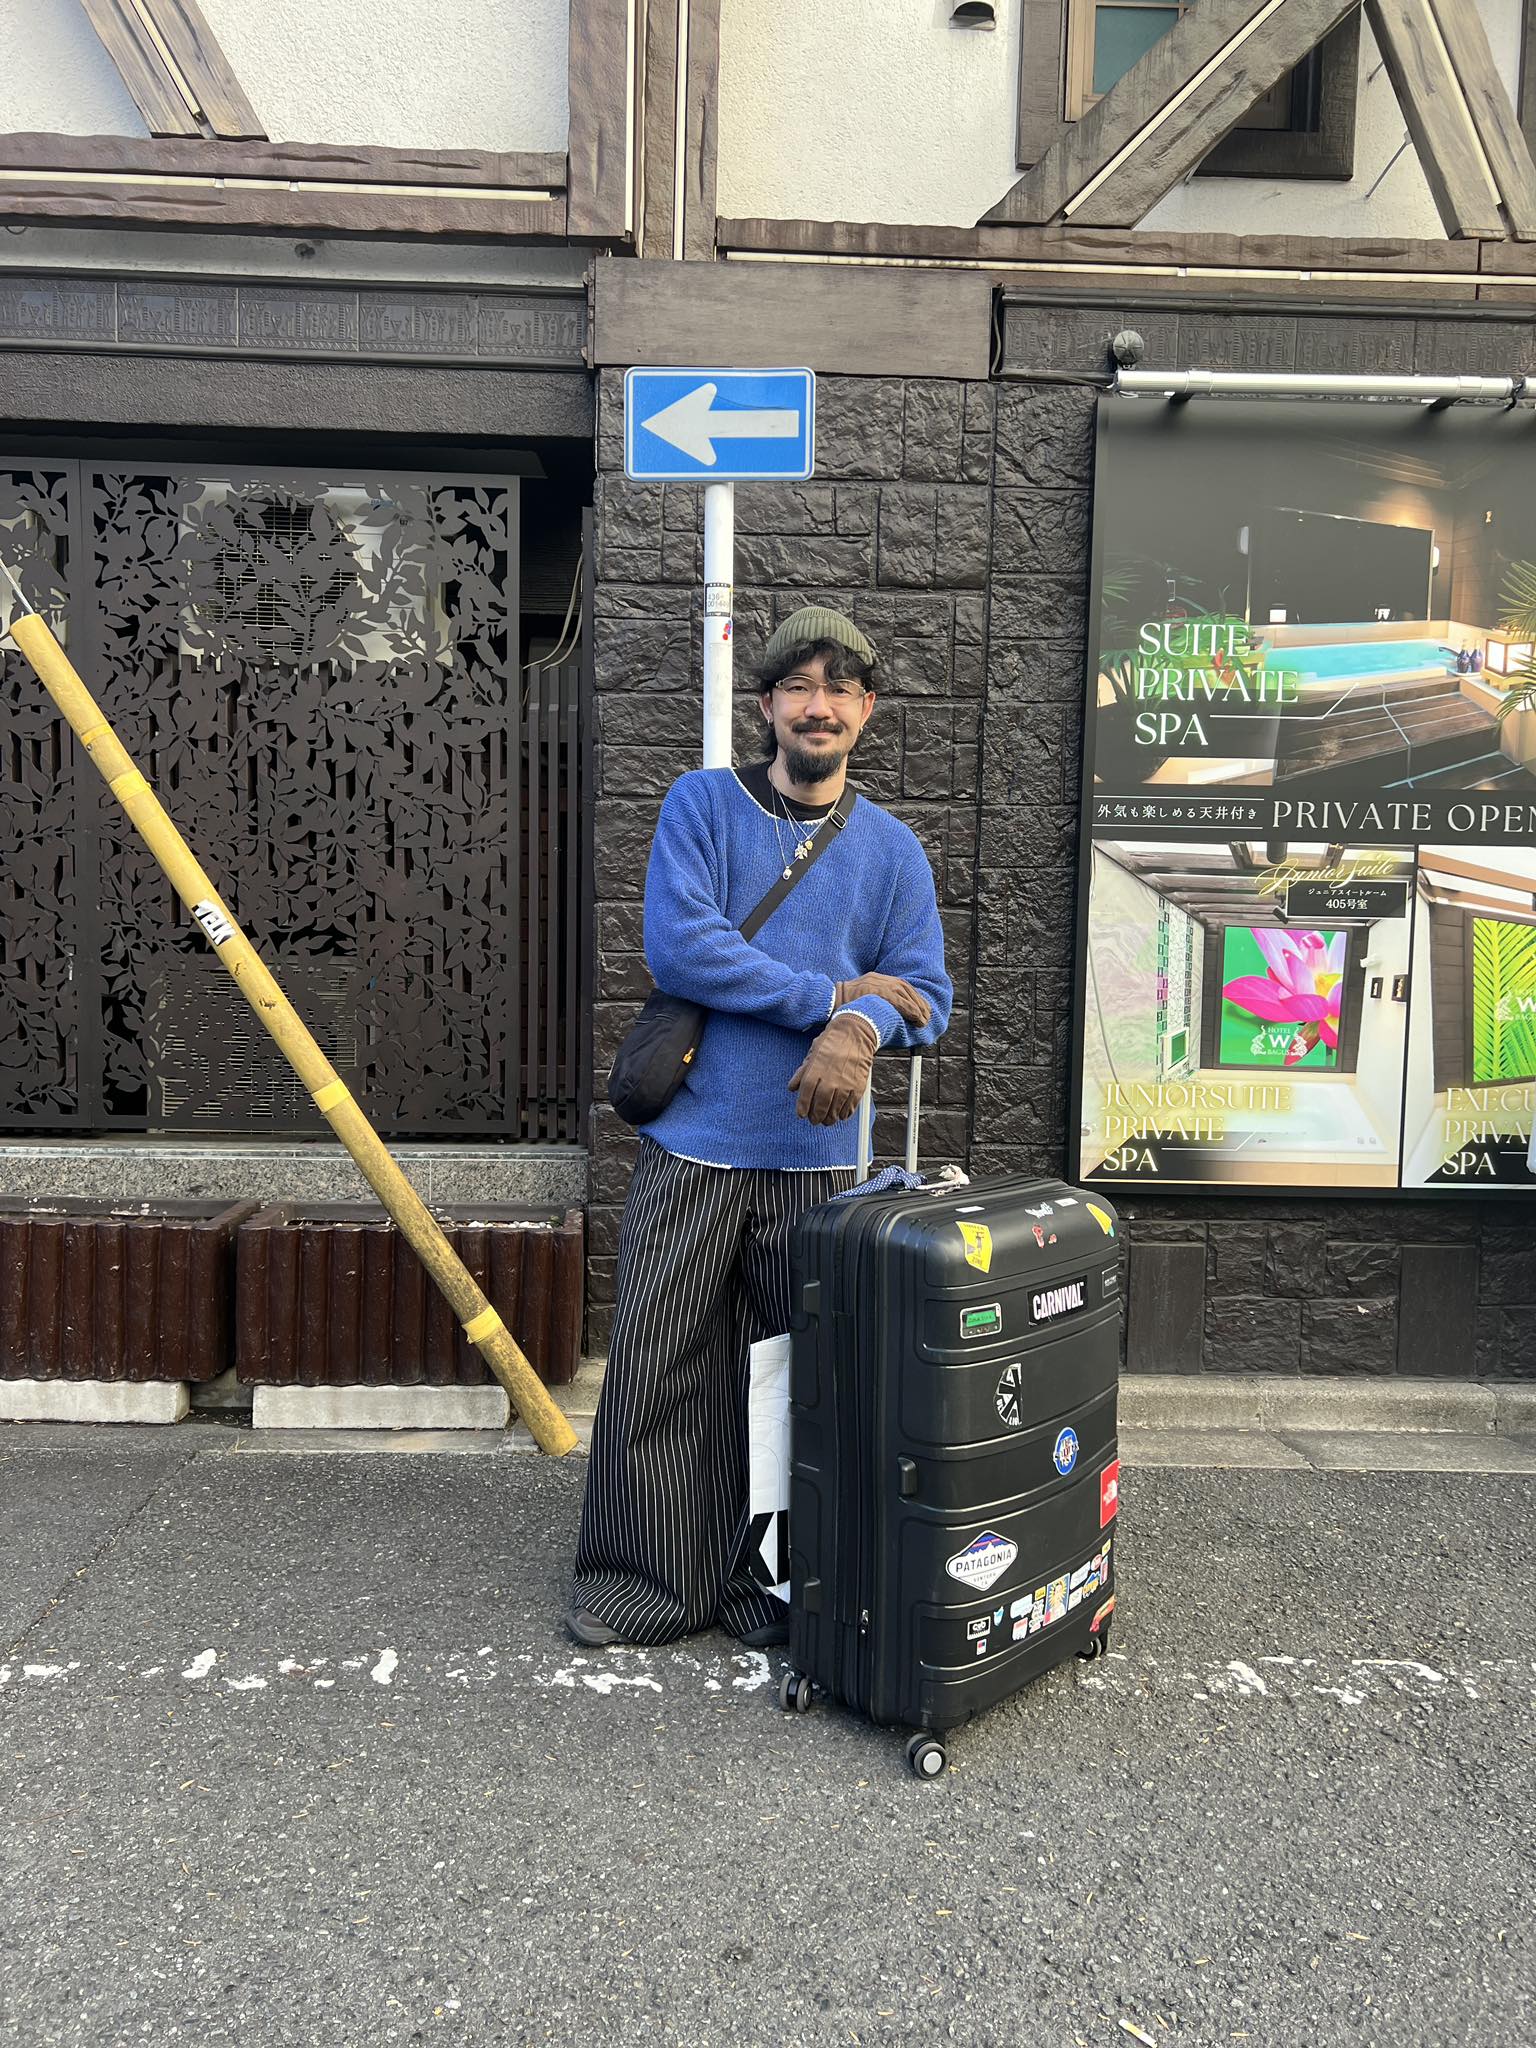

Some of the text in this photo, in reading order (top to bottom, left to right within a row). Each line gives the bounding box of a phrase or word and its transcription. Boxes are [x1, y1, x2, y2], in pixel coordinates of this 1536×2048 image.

[1138, 622, 1249, 656] SUITE
[1137, 668, 1299, 703] PRIVATE
[1134, 712, 1209, 745] SPA
[1097, 804, 1257, 820] 外気も楽しめる天井付き
[1272, 801, 1432, 831] PRIVATE
[1254, 858, 1346, 896] Junior
[1308, 888, 1387, 897] ジュニアスイートルーム
[1325, 899, 1368, 910] 405号室
[1268, 1034, 1291, 1048] W
[1101, 1083, 1291, 1111] JUNIORSUITE
[1105, 1115, 1224, 1141] PRIVATE
[1445, 1119, 1534, 1144] PRIVA
[1102, 1147, 1159, 1172] SPA
[1442, 1151, 1497, 1176] SPA
[1032, 1282, 1084, 1320] CARNIVAL
[955, 1549, 1012, 1573] PATAGONIA
